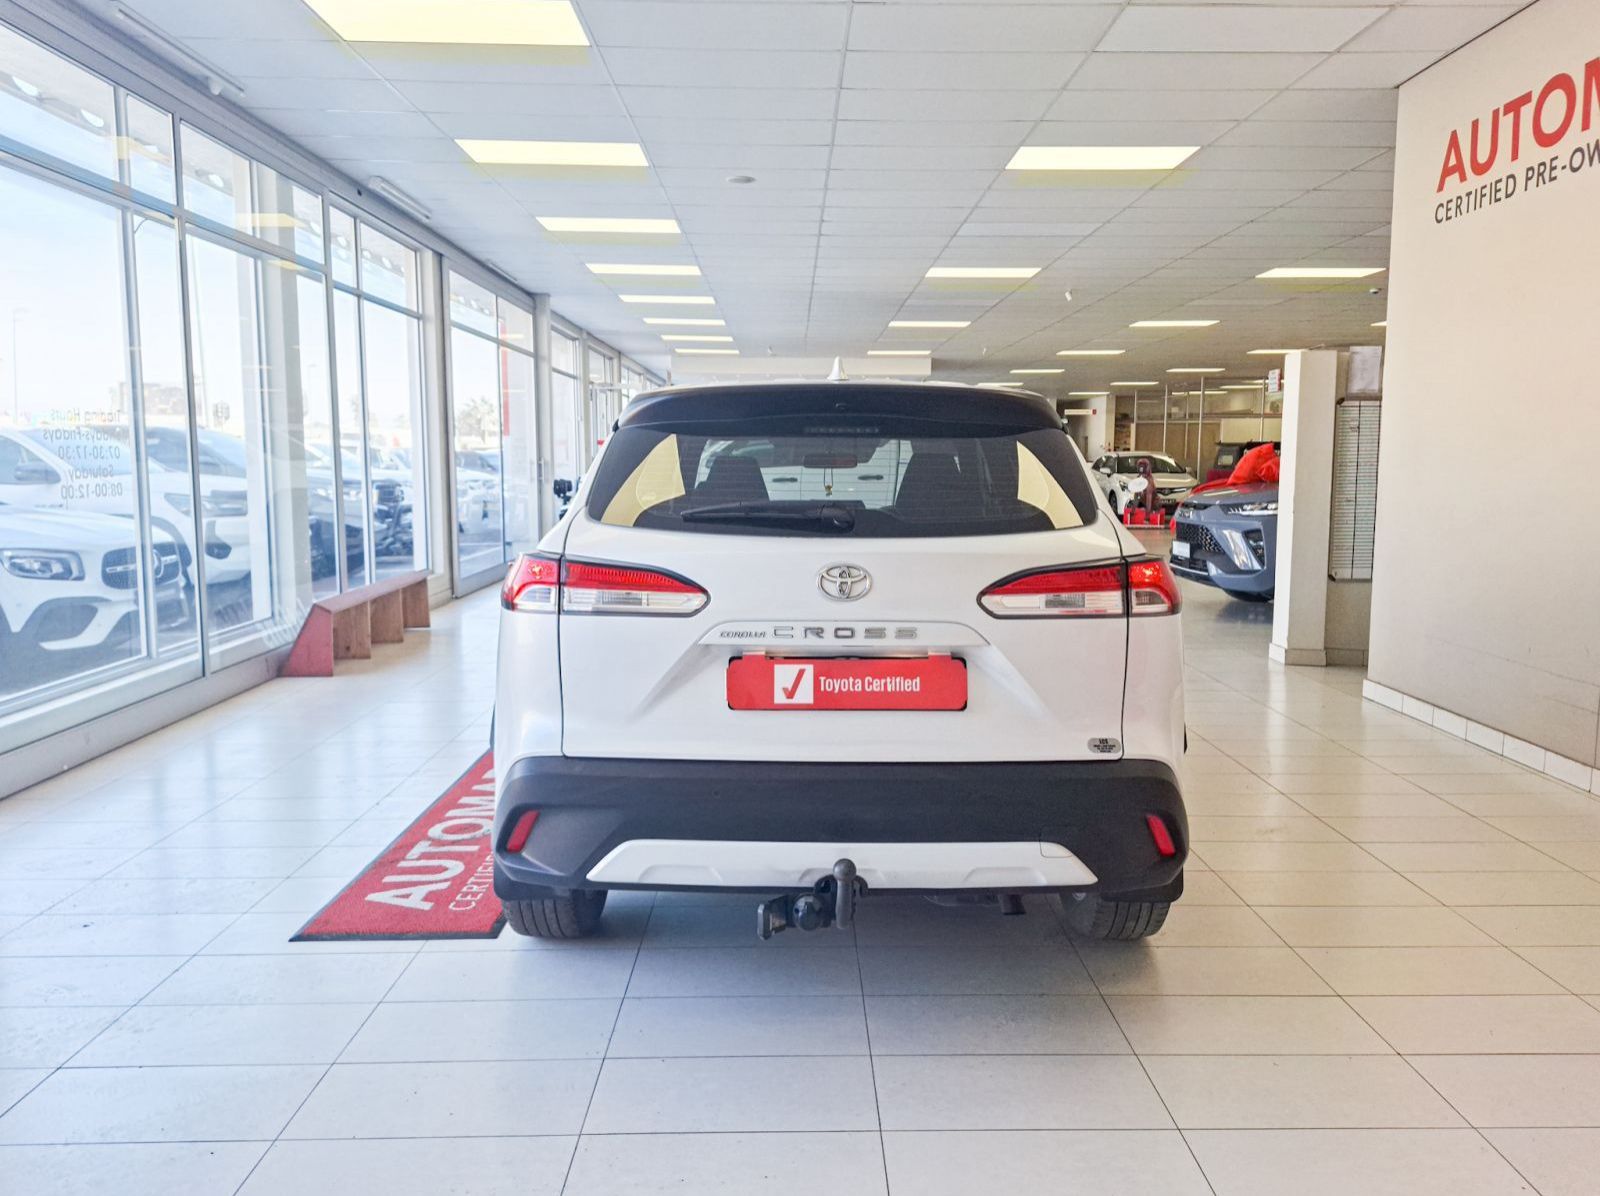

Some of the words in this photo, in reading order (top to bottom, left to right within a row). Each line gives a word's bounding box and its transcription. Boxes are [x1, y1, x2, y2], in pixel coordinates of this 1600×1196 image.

[1434, 173, 1517, 224] CERTIFIED
[720, 630, 766, 639] COROLLA
[773, 626, 918, 639] CROSS
[819, 676, 862, 693] Toyota
[864, 676, 920, 692] Certified
